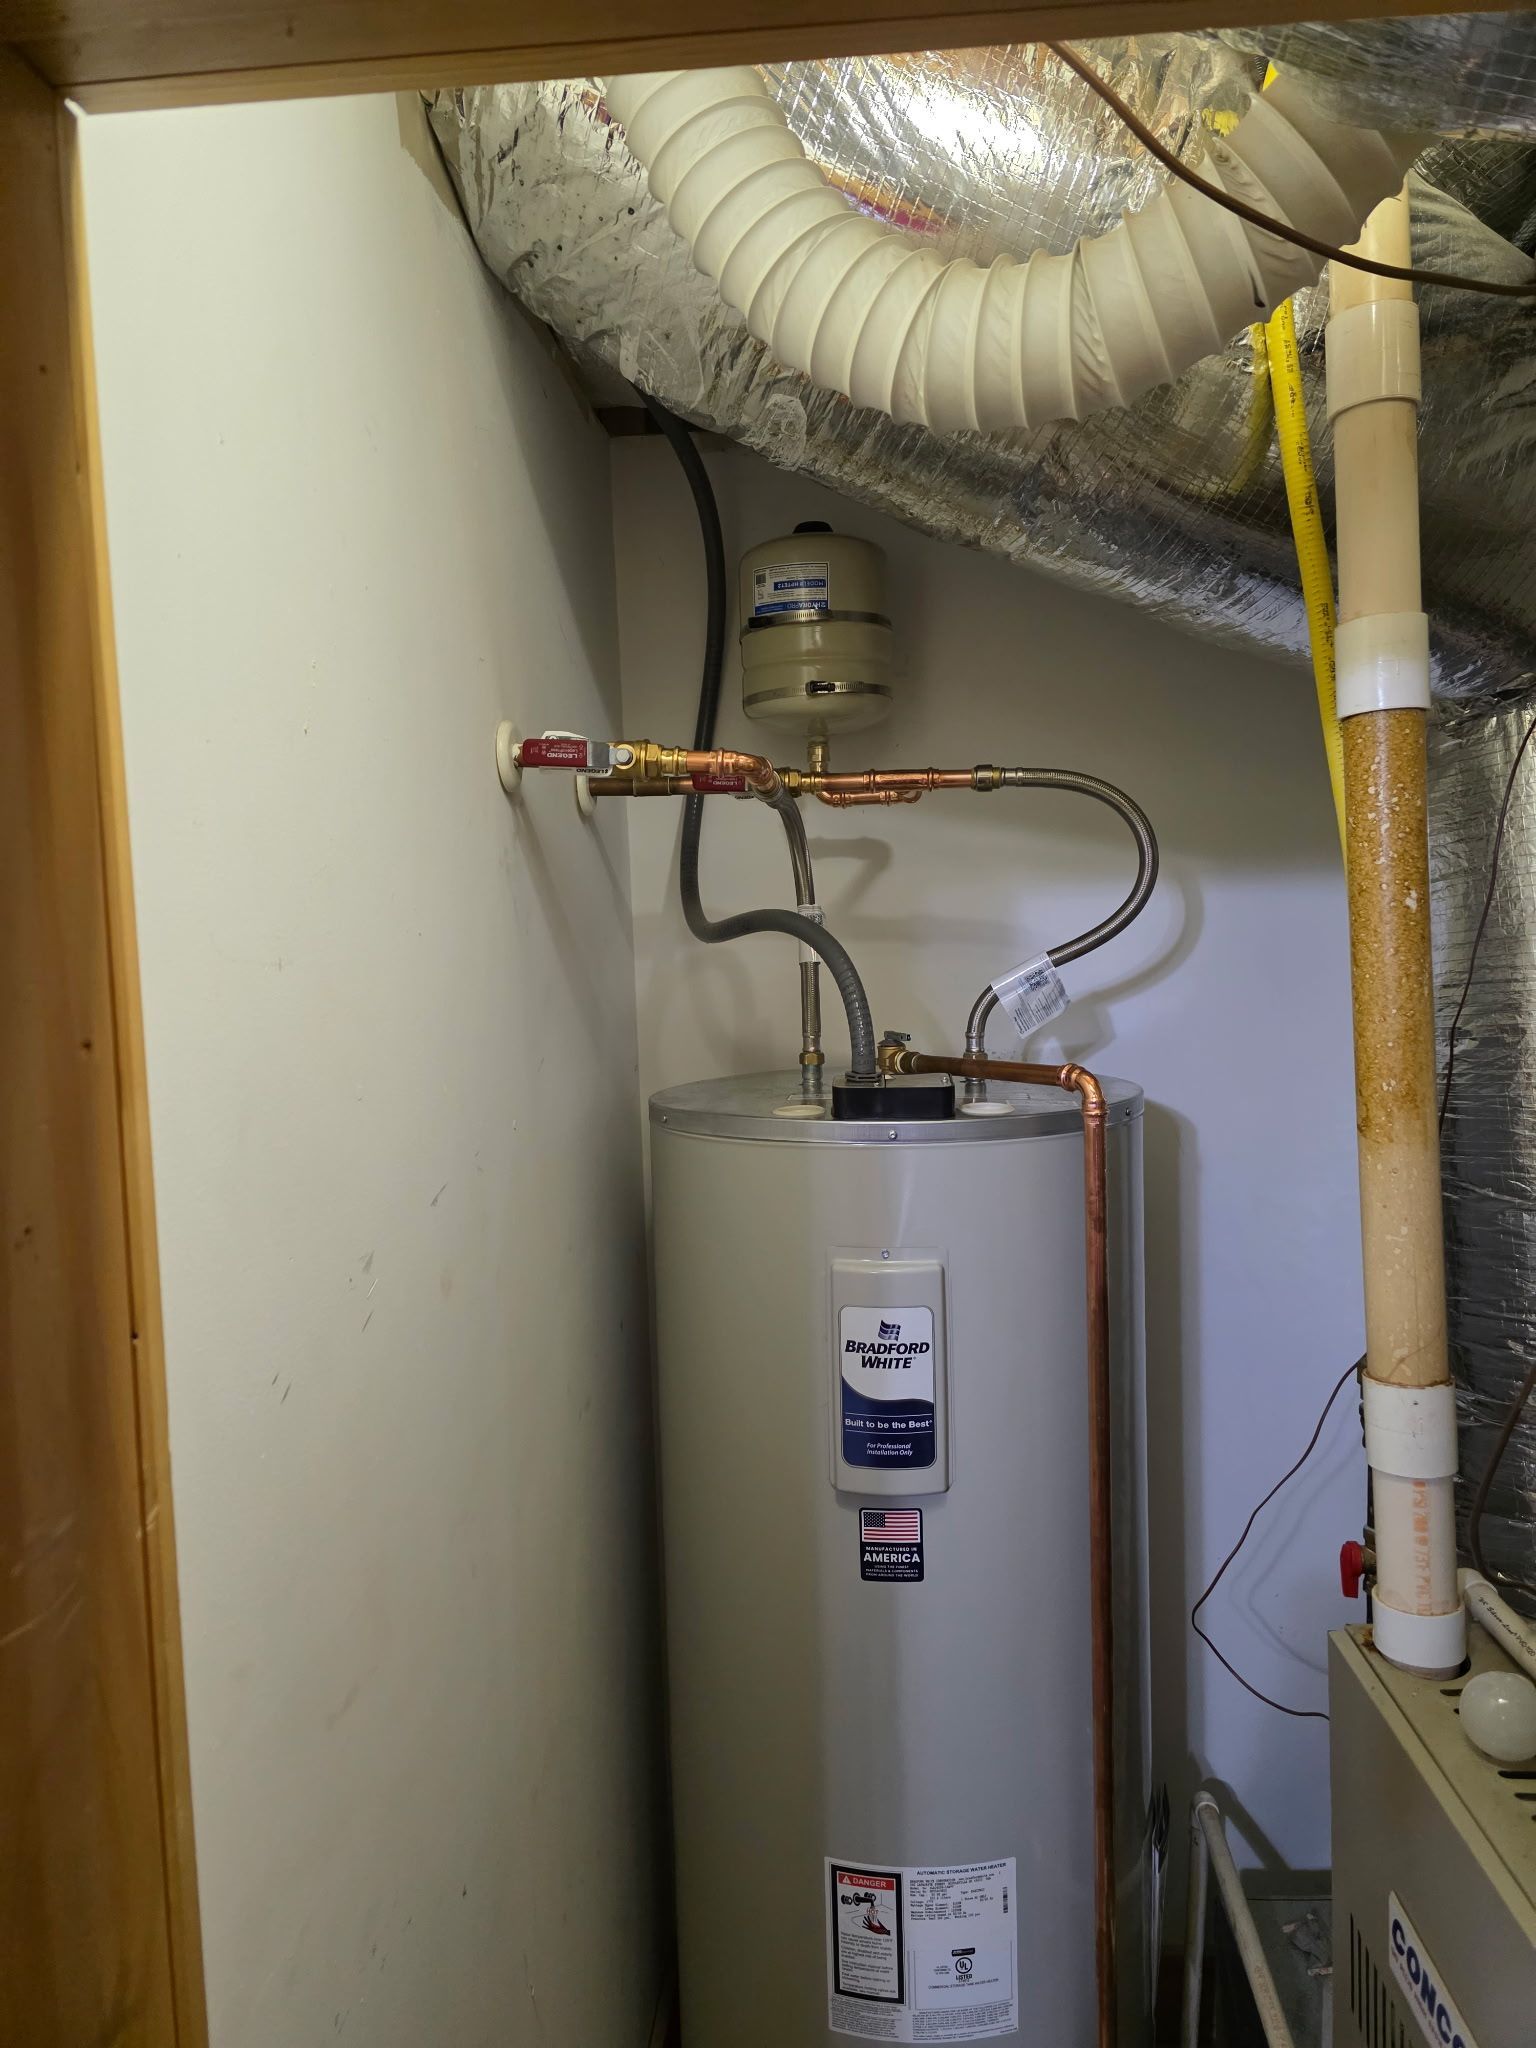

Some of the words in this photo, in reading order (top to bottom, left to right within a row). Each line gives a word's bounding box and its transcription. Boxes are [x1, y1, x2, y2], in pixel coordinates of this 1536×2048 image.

[845, 1340, 930, 1355] BRADFORD
[861, 1355, 912, 1369] WHITE
[845, 1418, 864, 1427] Built
[892, 1421, 906, 1429] the
[908, 1420, 930, 1428] Best
[899, 1449, 913, 1457] Only
[863, 1552, 921, 1563] AMERICA
[852, 1877, 887, 1888] DANGER
